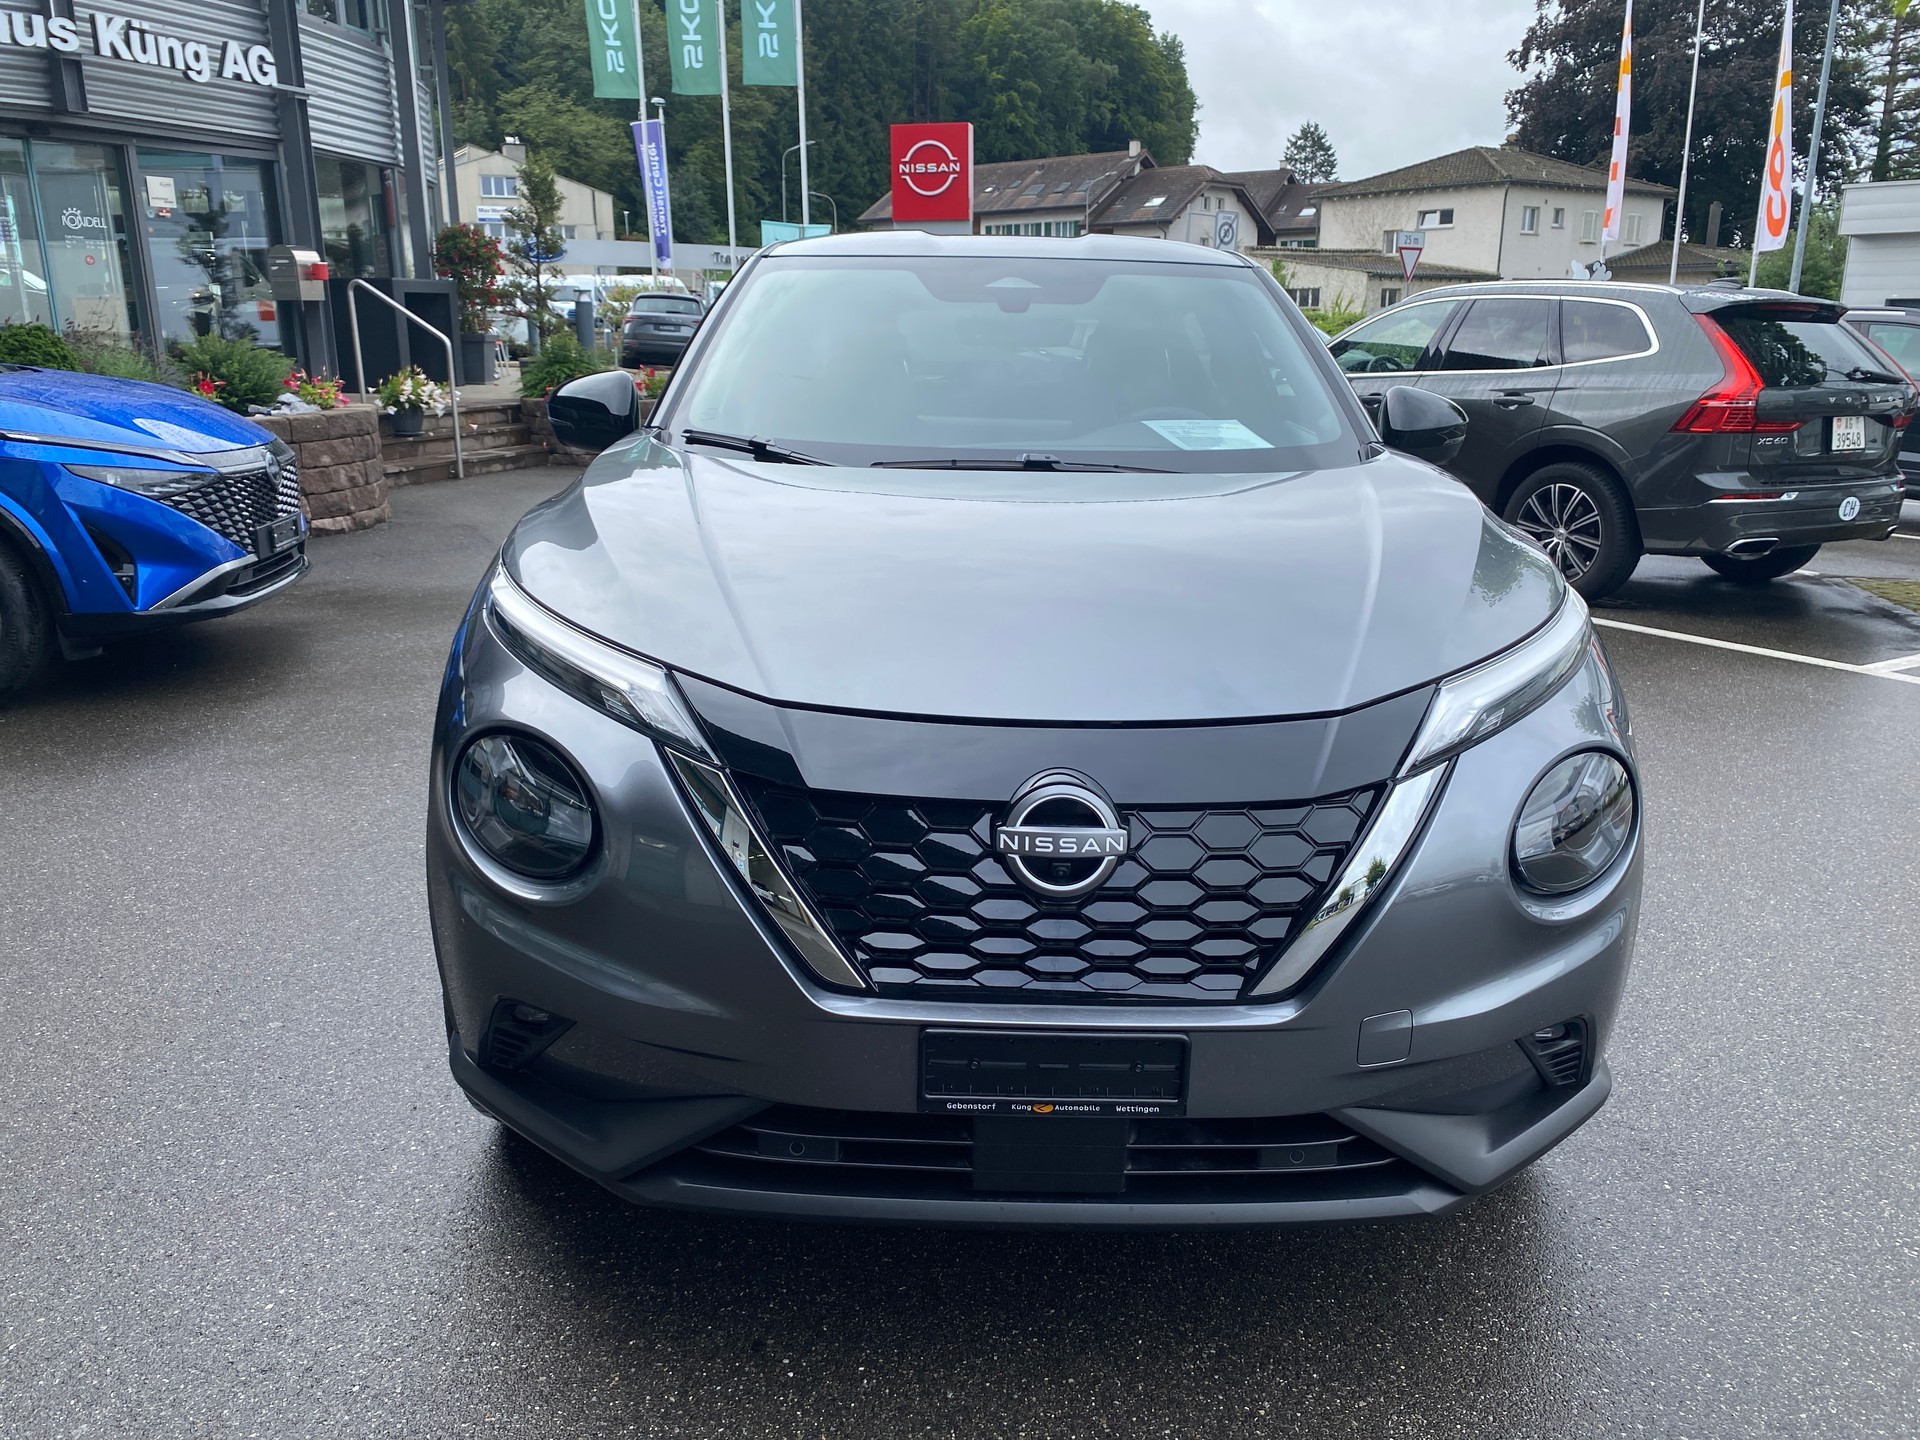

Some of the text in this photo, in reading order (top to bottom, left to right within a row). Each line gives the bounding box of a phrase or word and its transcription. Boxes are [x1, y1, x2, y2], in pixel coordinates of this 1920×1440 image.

[92, 13, 210, 83] Küng
[220, 40, 278, 87] AG
[899, 162, 960, 173] NISSAN
[1404, 234, 1412, 245] 25
[1828, 395, 1894, 404] VOLVO
[1844, 417, 1853, 429] AG
[1836, 432, 1862, 448] 39548
[1842, 500, 1857, 517] CH
[1000, 833, 1124, 853] NISSAN
[946, 1102, 996, 1110] Gebenstorf
[1011, 1103, 1032, 1111] Küng
[1116, 1105, 1160, 1113] Wettingen
